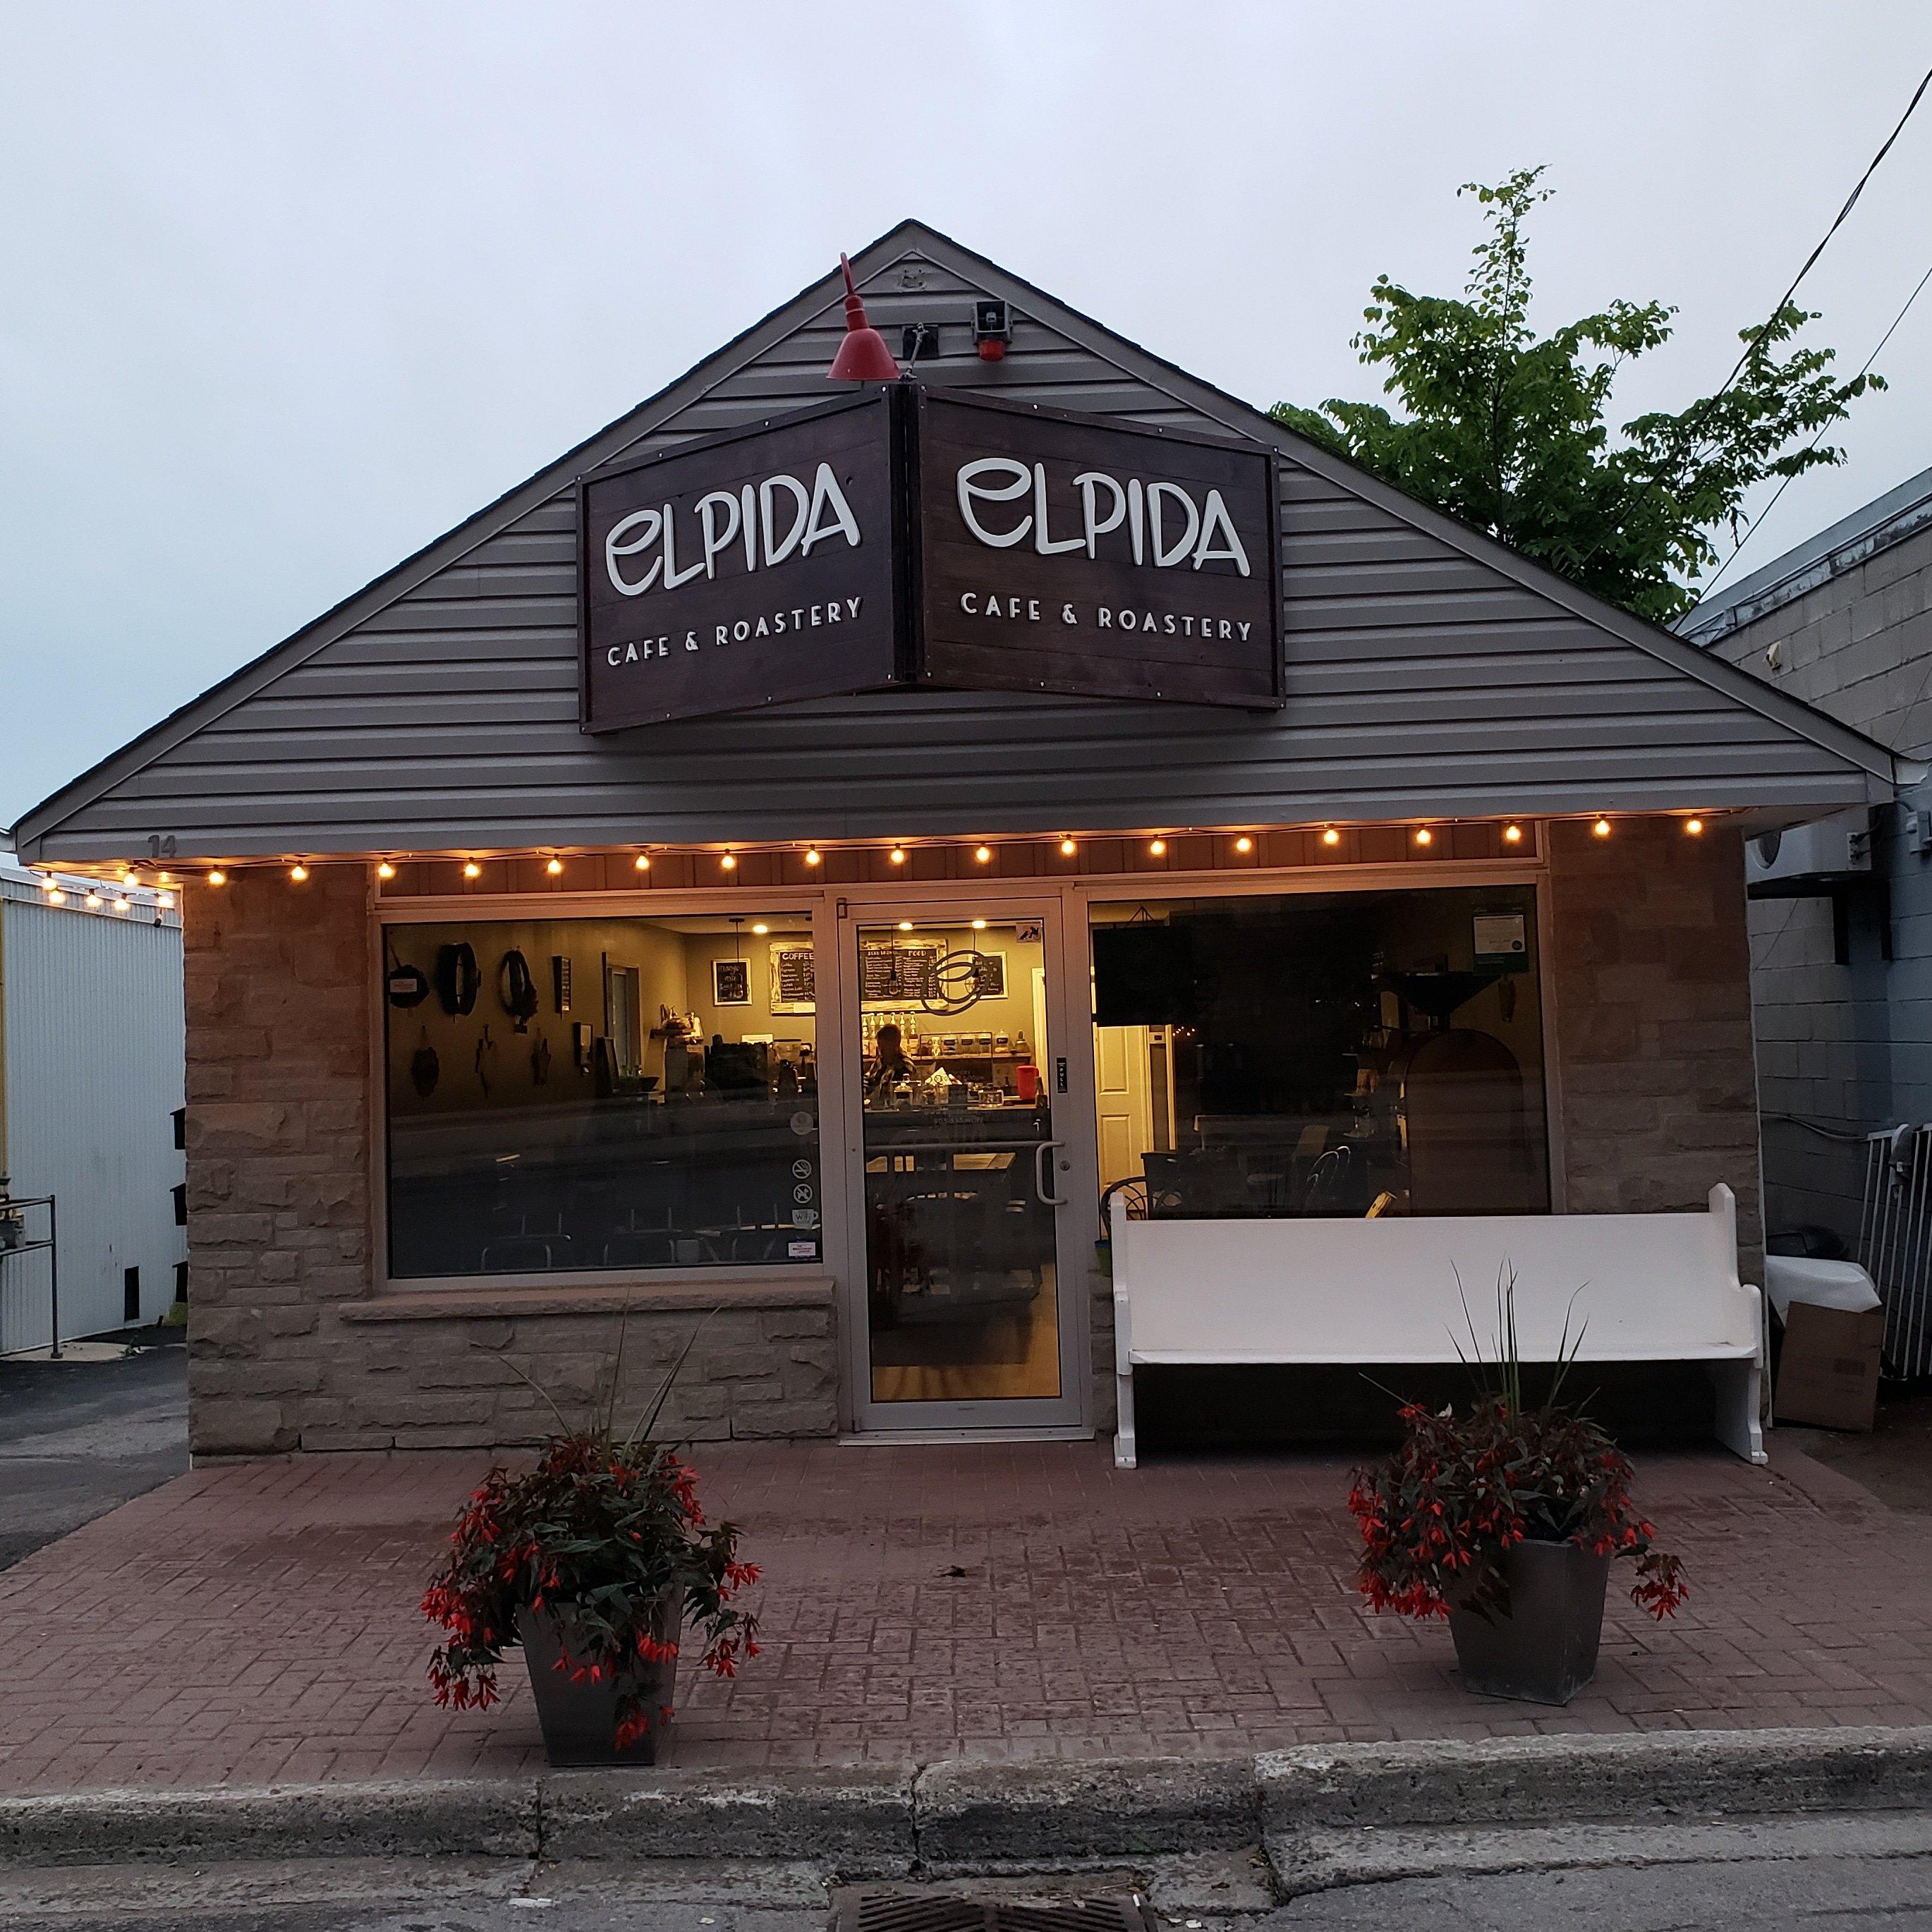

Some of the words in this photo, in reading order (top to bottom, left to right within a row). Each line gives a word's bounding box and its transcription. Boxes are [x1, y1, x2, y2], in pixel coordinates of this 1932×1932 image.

[607, 636, 670, 667] CAFE
[685, 631, 699, 651] &
[715, 596, 862, 647] ROASTERY
[960, 592, 1041, 621] CAFE
[1062, 603, 1079, 625] &
[1098, 607, 1252, 642] ROASTERY
[147, 834, 176, 858] 14
